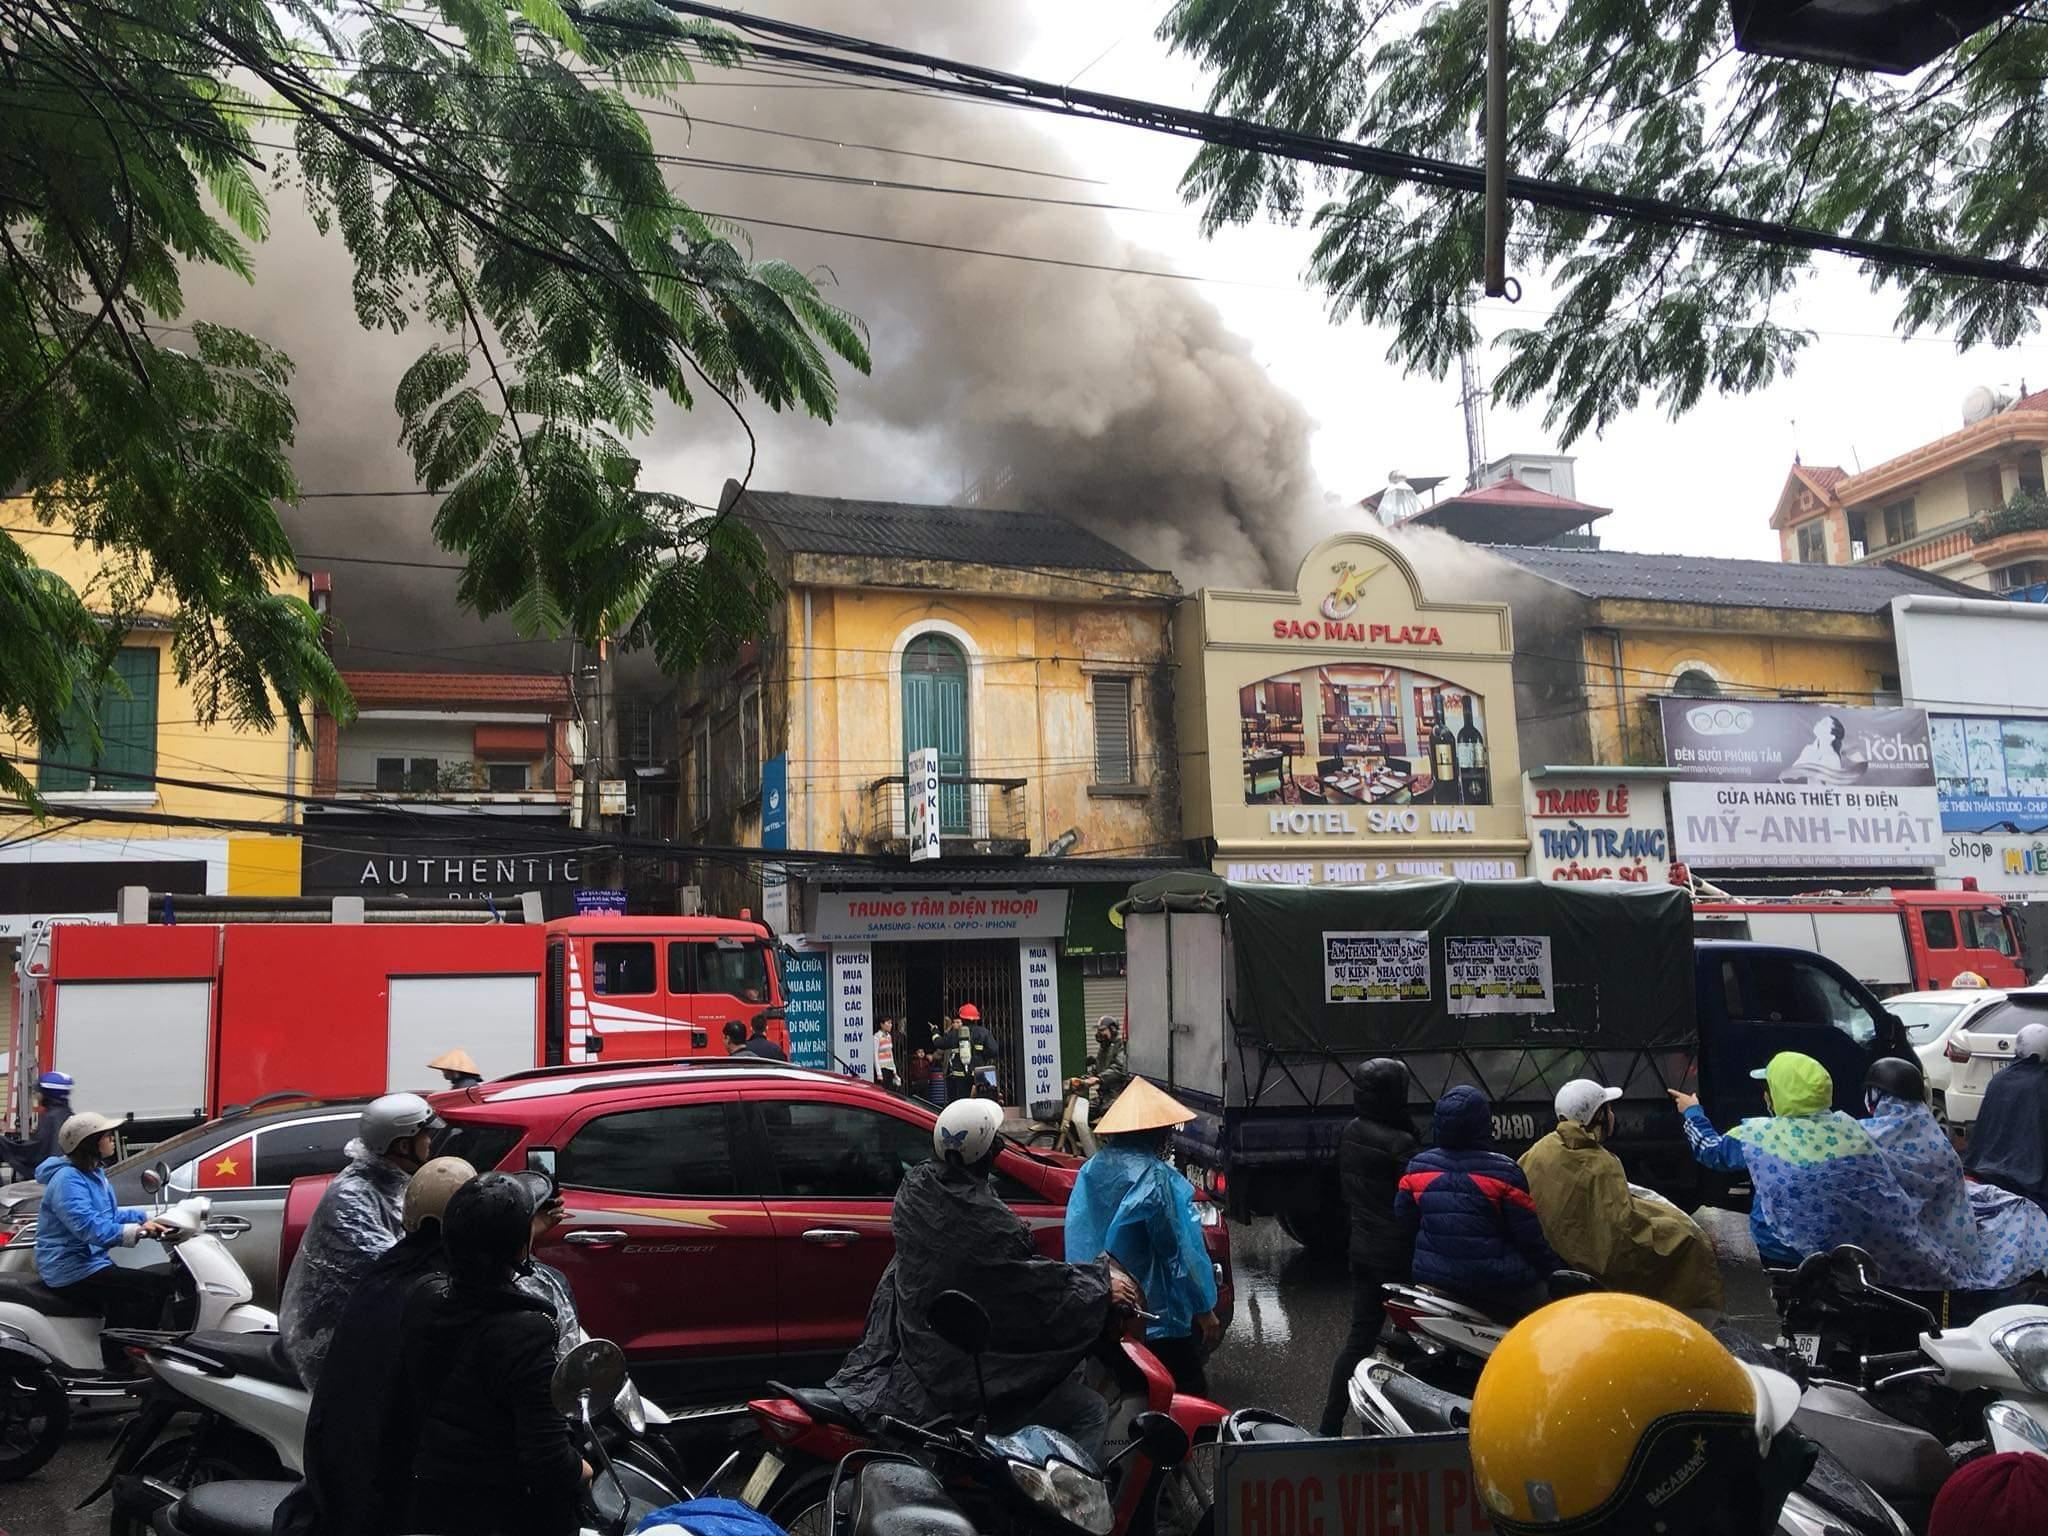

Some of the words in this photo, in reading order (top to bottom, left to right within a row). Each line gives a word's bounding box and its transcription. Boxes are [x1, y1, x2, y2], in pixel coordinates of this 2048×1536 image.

[1273, 619, 1320, 639] SAO
[1325, 622, 1365, 642] MAI
[1369, 623, 1443, 645] PLAZA
[926, 760, 939, 846] NOKIA
[1536, 788, 1601, 814] TRANG
[1717, 787, 1750, 805] CỬA
[1754, 788, 1796, 806] HÀNG
[1800, 788, 1841, 807] THIẾT
[1849, 793, 1862, 810] BỊ
[1864, 792, 1899, 809] ĐIỆN
[1269, 809, 1358, 833] HOTEL
[1367, 809, 1420, 833] SAO
[1430, 809, 1476, 833] MAI
[1539, 820, 1589, 860] THỜI
[1591, 828, 1665, 862] TRANG
[1949, 837, 1993, 863] Shop
[360, 859, 579, 884] AUTHENTIC
[848, 900, 907, 917] TRUNG
[911, 896, 944, 917] TÂM
[948, 896, 986, 919] ĐIỆN
[991, 899, 1039, 919] THOẠI
[868, 922, 911, 932] SAMSUNG
[917, 921, 946, 931] NOKIA
[953, 921, 979, 930] OPPO
[985, 920, 1017, 930] IPHONE
[1029, 948, 1047, 959] MUA
[1347, 944, 1378, 958] THANH
[1401, 943, 1426, 957] SÁNG
[1466, 944, 1495, 957] THANH
[1516, 942, 1541, 957] SÁNG
[842, 969, 862, 980] MUA
[805, 977, 821, 992] BÁN
[843, 984, 862, 995] BÁN
[1029, 978, 1050, 988] TRAO
[802, 1000, 825, 1014] THOẠI
[1031, 1007, 1050, 1020] ĐIỆN
[844, 1016, 864, 1030] LOẠI
[1030, 1023, 1053, 1035] THOẠI
[844, 1031, 863, 1043] MÁY
[1037, 1039, 1046, 1049] DI
[850, 1048, 859, 1058] DI
[1031, 1053, 1054, 1067] ĐỘNG
